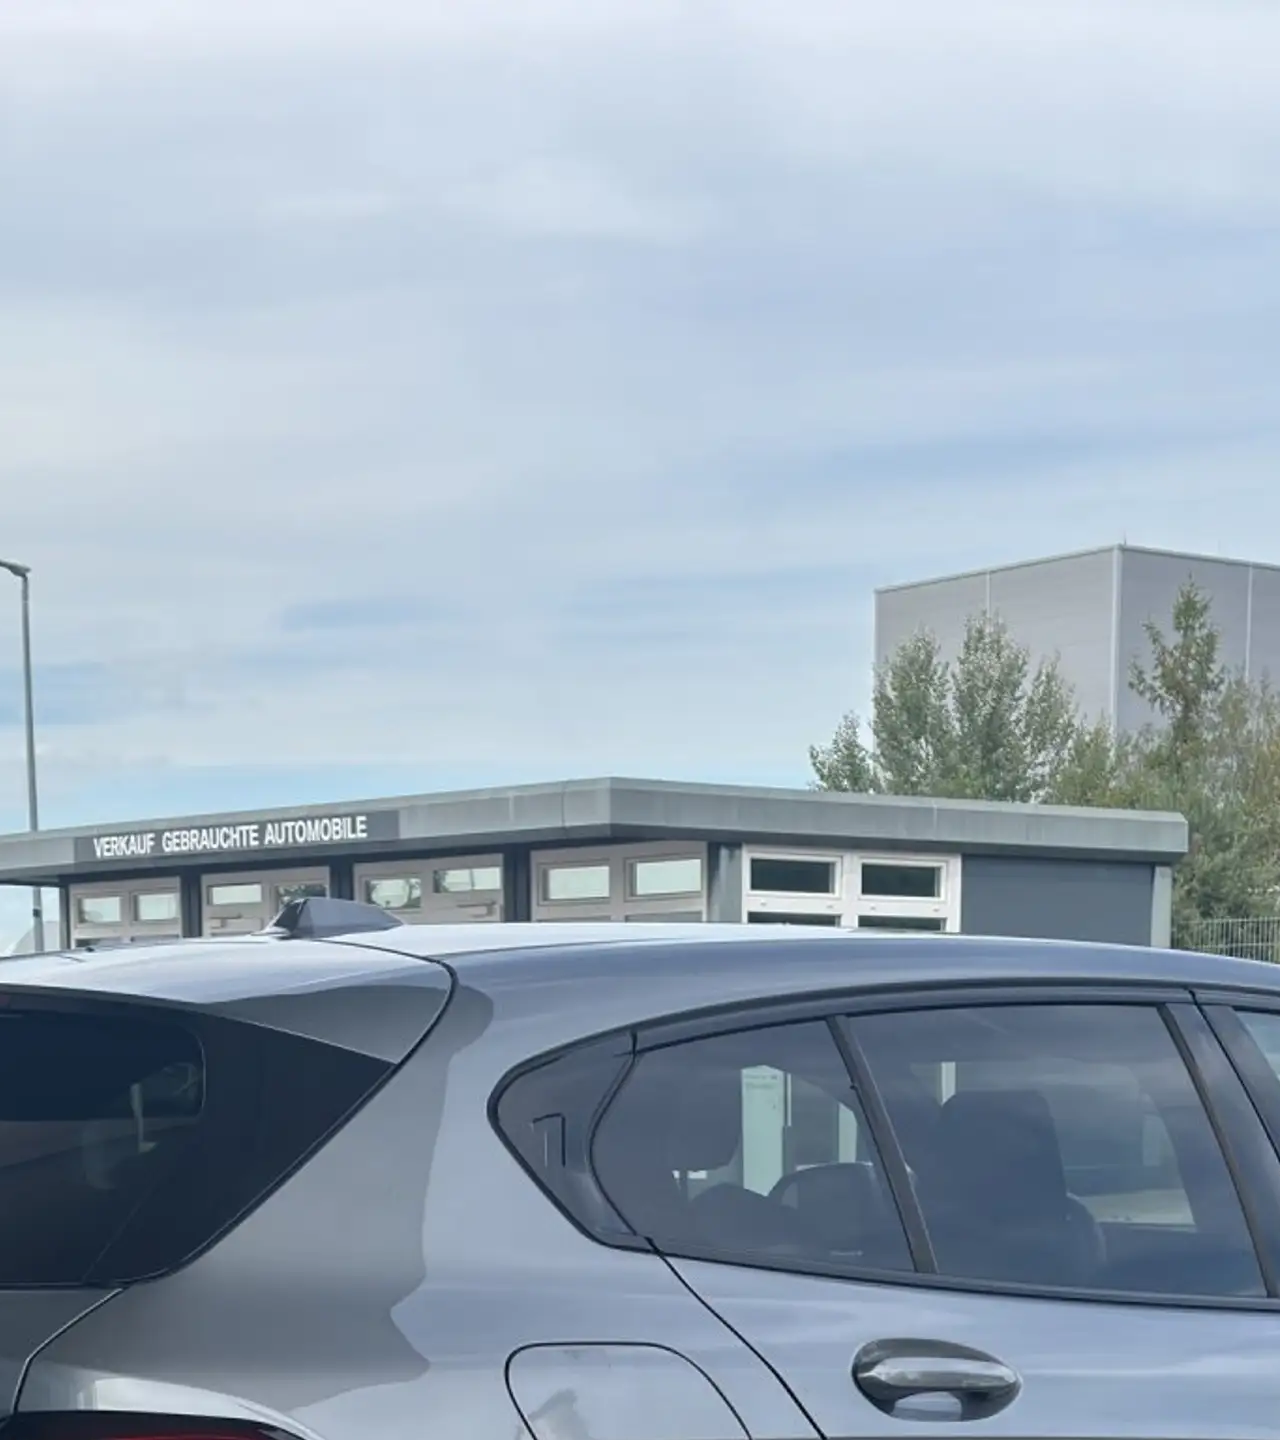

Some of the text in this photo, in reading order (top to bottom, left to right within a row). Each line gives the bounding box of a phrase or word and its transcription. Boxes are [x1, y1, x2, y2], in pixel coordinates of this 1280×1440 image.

[93, 815, 368, 858] VERKAUF GEBRAUCHTE AUTOMOBILE
